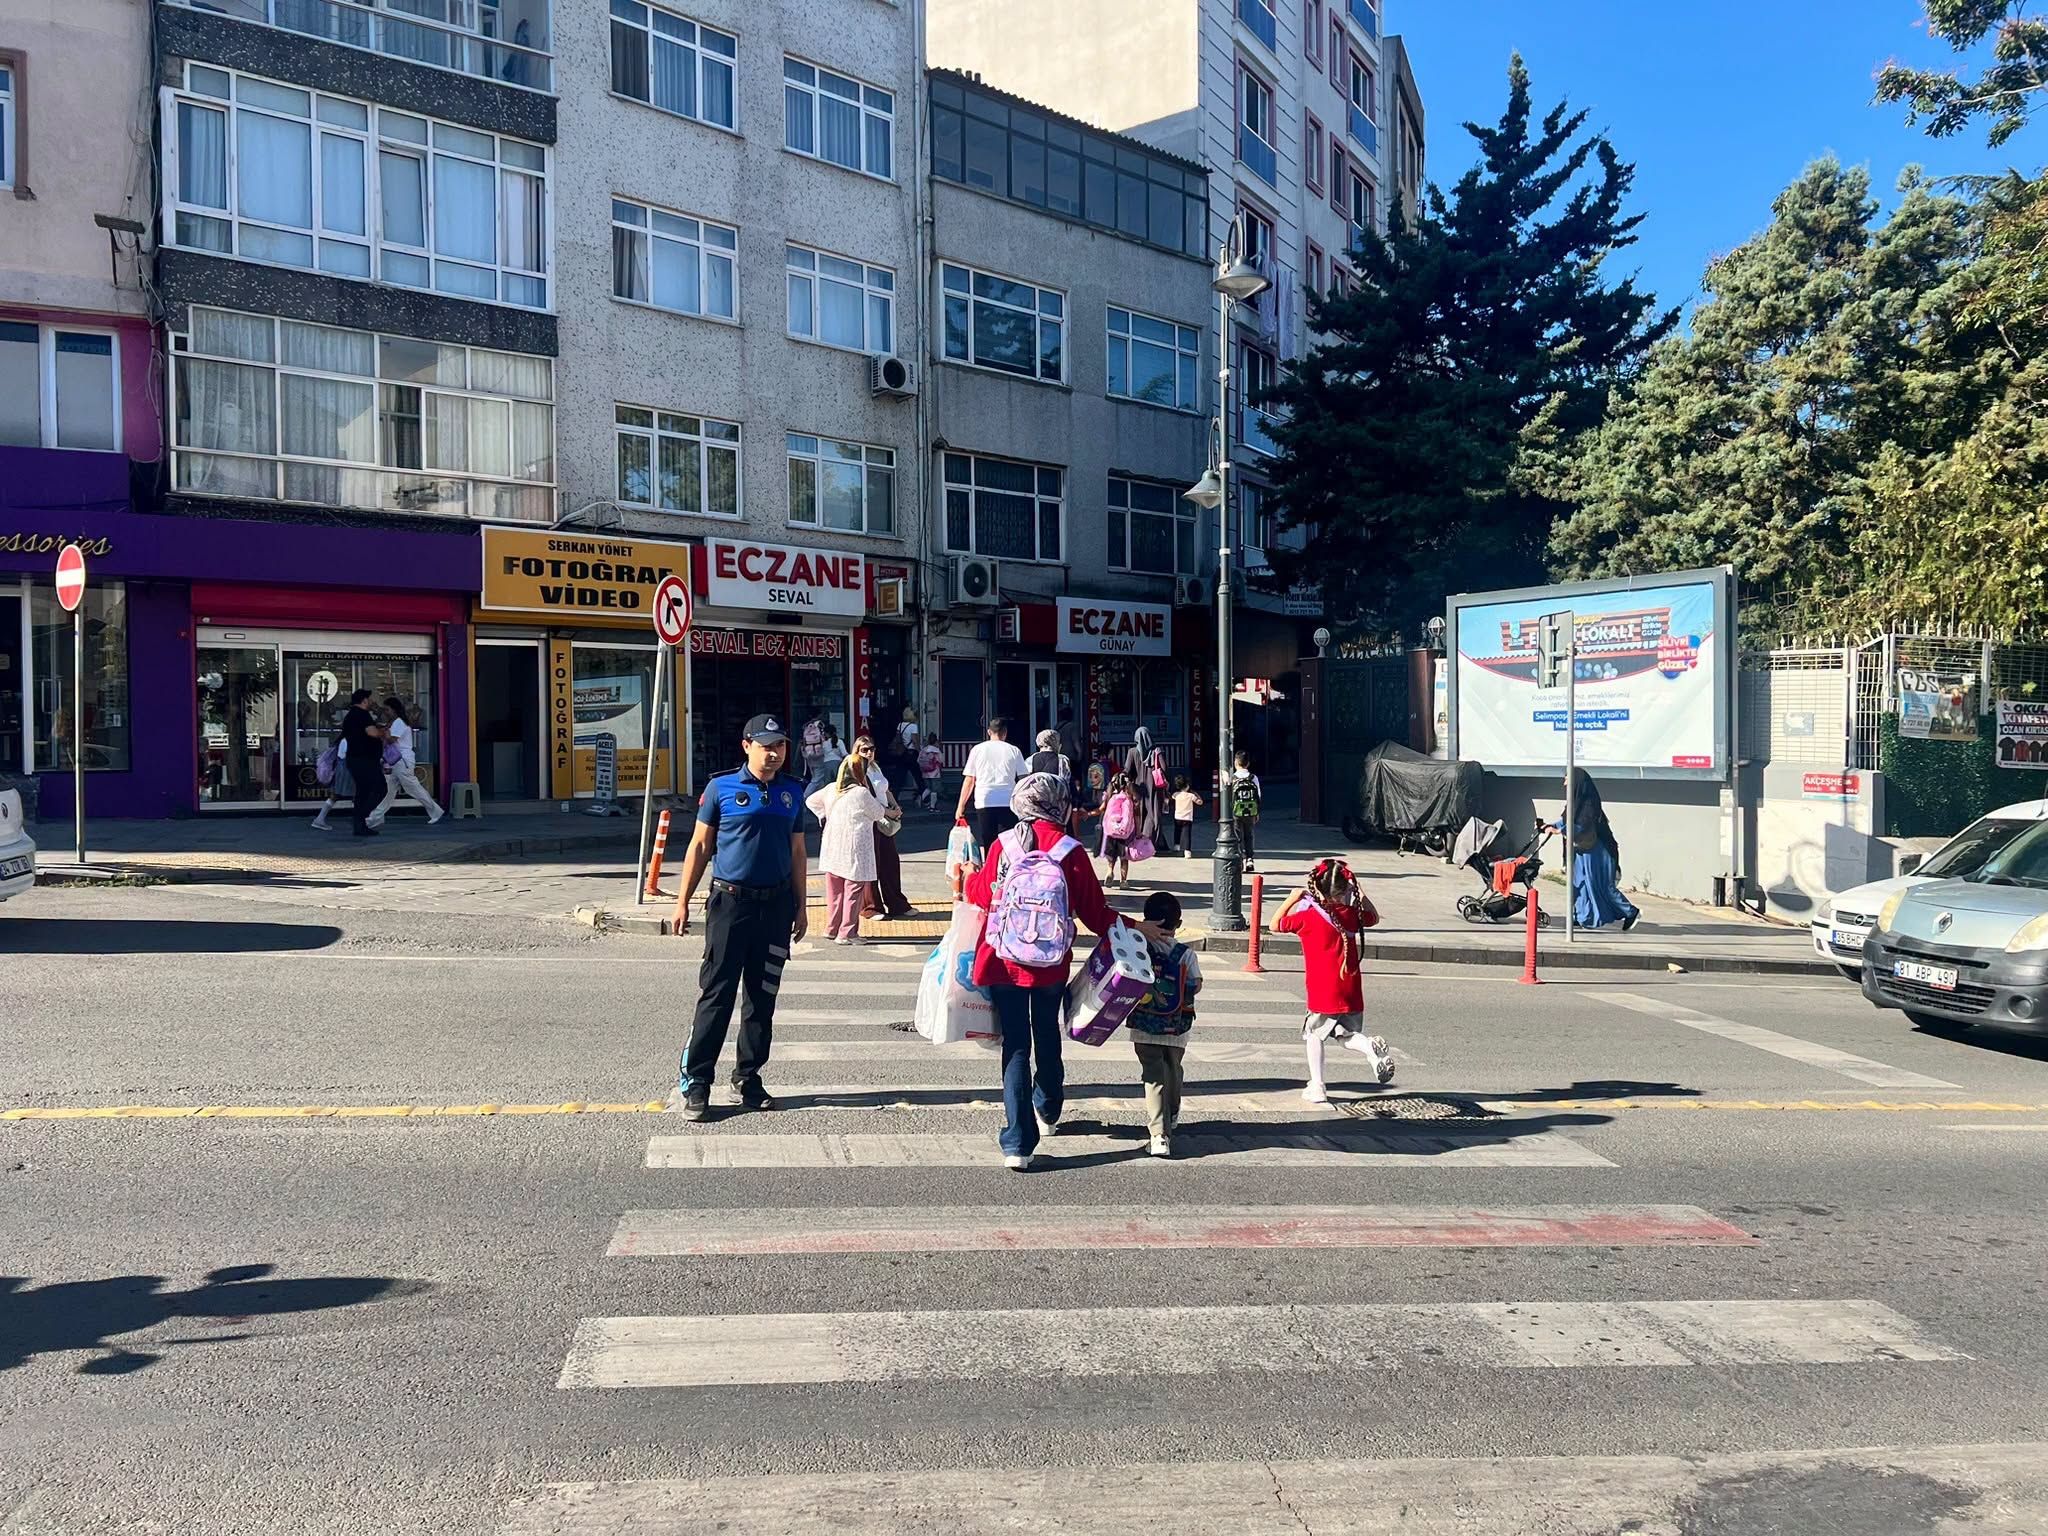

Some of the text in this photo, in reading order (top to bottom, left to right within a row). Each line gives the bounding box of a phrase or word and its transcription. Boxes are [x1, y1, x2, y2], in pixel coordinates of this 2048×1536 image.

[548, 539, 633, 557] SERKAN YÖNET
[503, 556, 673, 584] FOTOĞRAF
[715, 544, 862, 590] ECZANE
[539, 583, 640, 609] VİDEO
[768, 588, 814, 605] SEVAL
[1069, 607, 1165, 638] ECZANE
[690, 630, 748, 655] SEVAL
[1099, 637, 1136, 652] GÜNAY
[555, 652, 568, 769] FOTOĞRAF
[1089, 664, 1099, 760] ECZANE
[1193, 669, 1201, 759] ECZANE
[2013, 703, 2048, 713] OKUL
[2002, 725, 2025, 734] OZAN
[1899, 963, 1955, 985] 81 ABP 490
